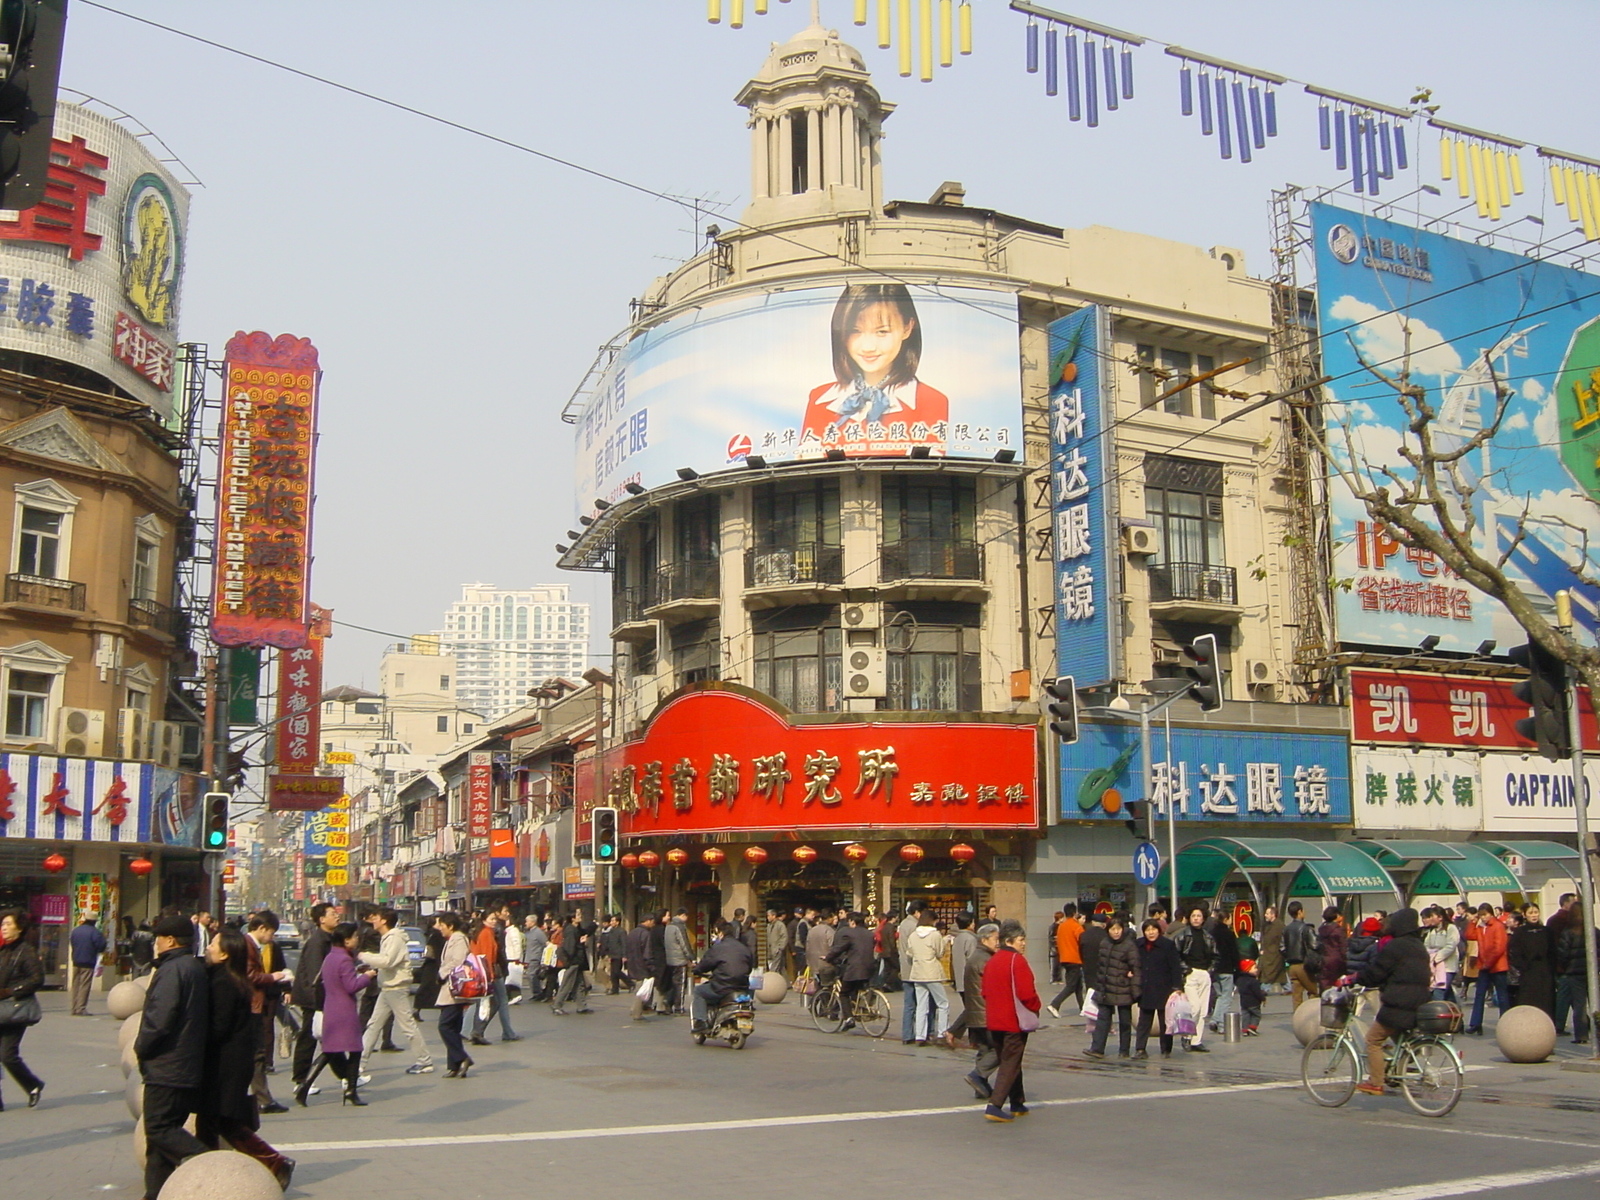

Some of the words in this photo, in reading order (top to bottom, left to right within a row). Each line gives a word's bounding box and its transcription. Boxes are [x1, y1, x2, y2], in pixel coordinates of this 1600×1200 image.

[761, 422, 1010, 448] 新华人寿保险股份有限公司
[1053, 388, 1095, 621] 科达眼镜
[1357, 576, 1473, 622] 省钱新捷径
[1150, 761, 1331, 815] 科达眼镜
[1366, 771, 1474, 807] 胖妹火锅
